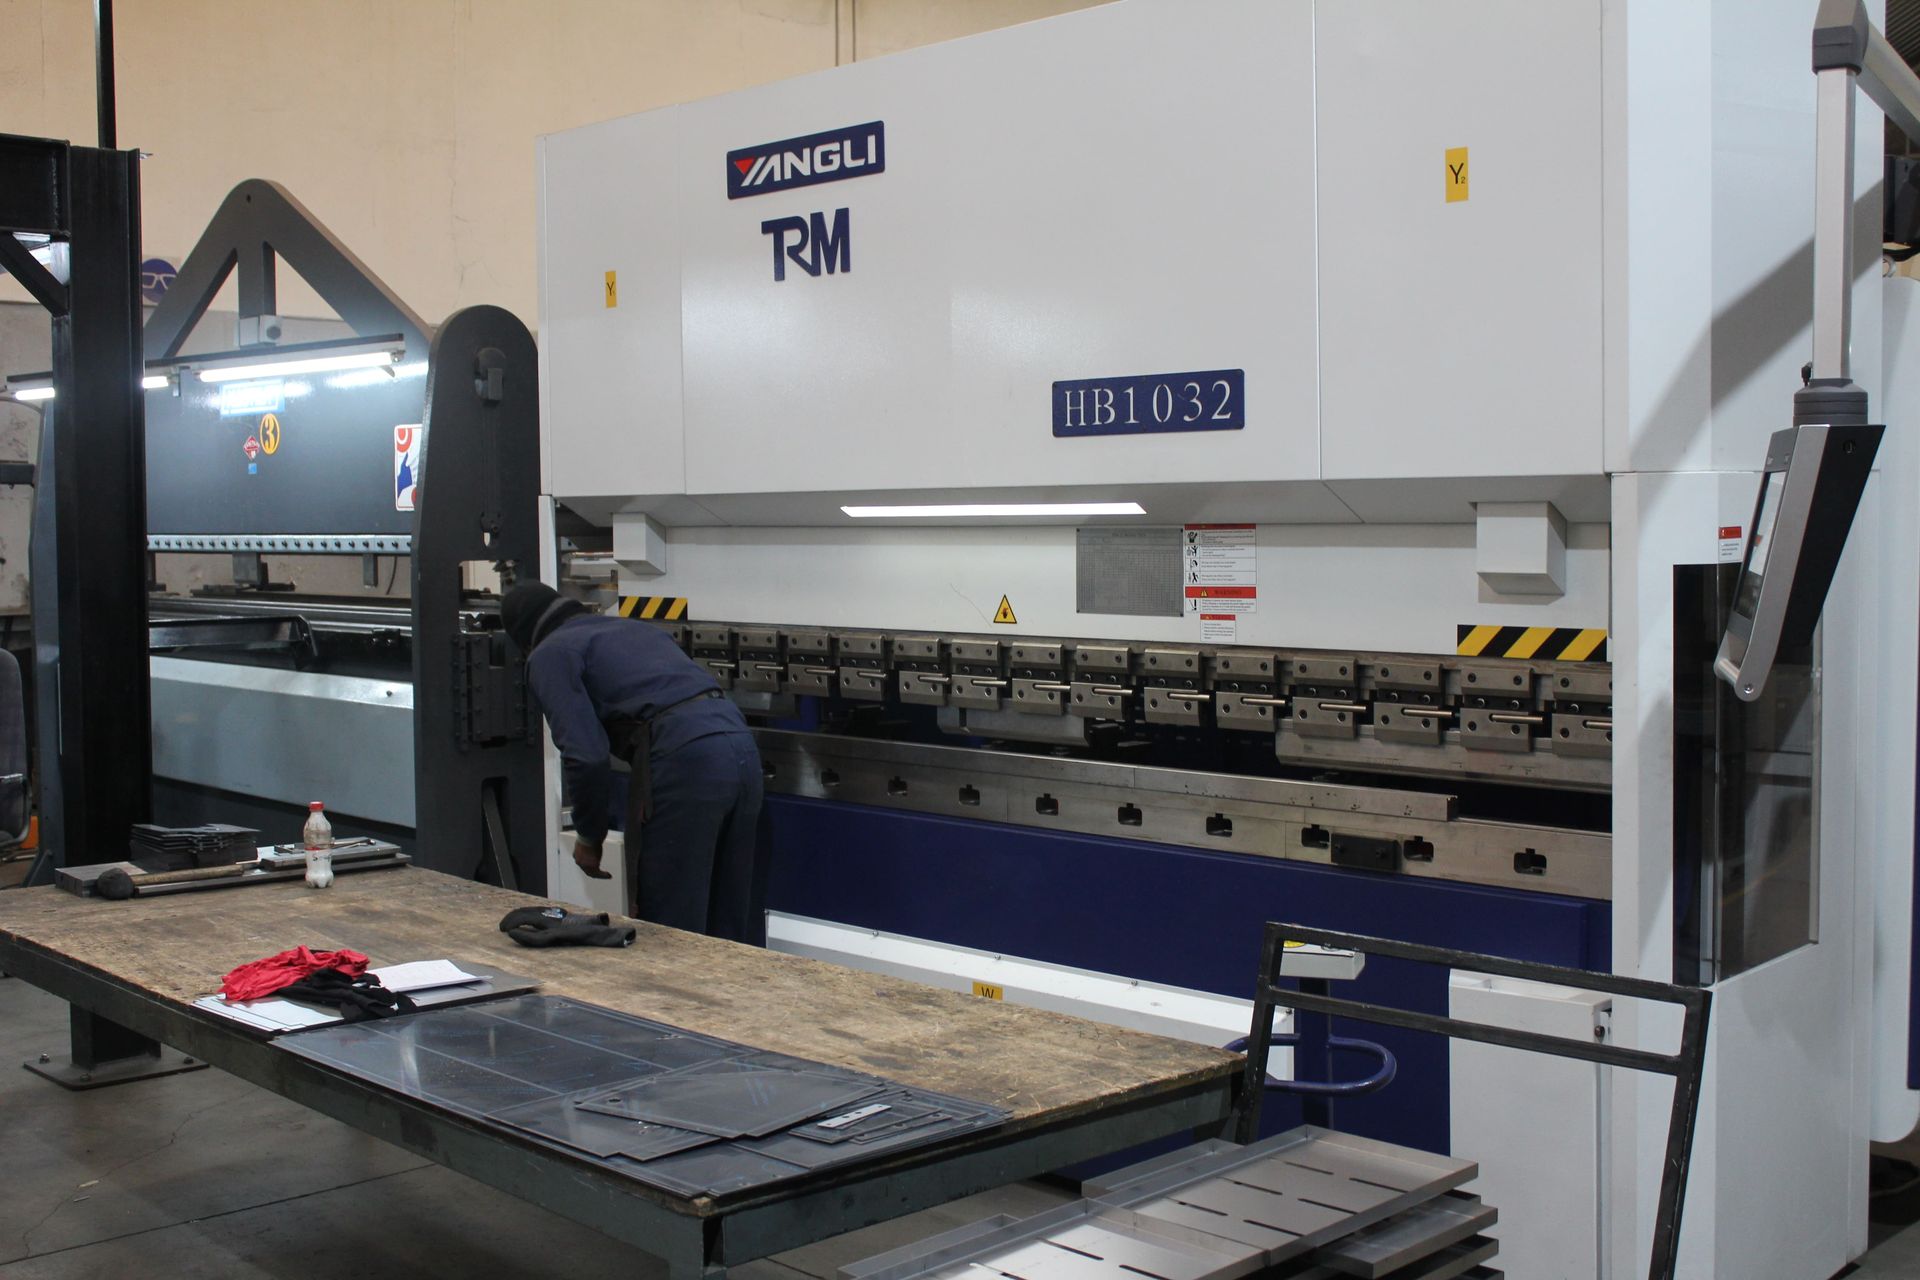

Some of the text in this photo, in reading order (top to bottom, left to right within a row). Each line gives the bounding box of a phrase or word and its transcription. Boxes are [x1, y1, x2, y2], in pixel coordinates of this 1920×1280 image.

[734, 134, 876, 187] YANGLI
[761, 207, 851, 282] TRM
[1065, 380, 1232, 427] HB1032
[264, 414, 276, 453] 3
[981, 986, 995, 999] W
